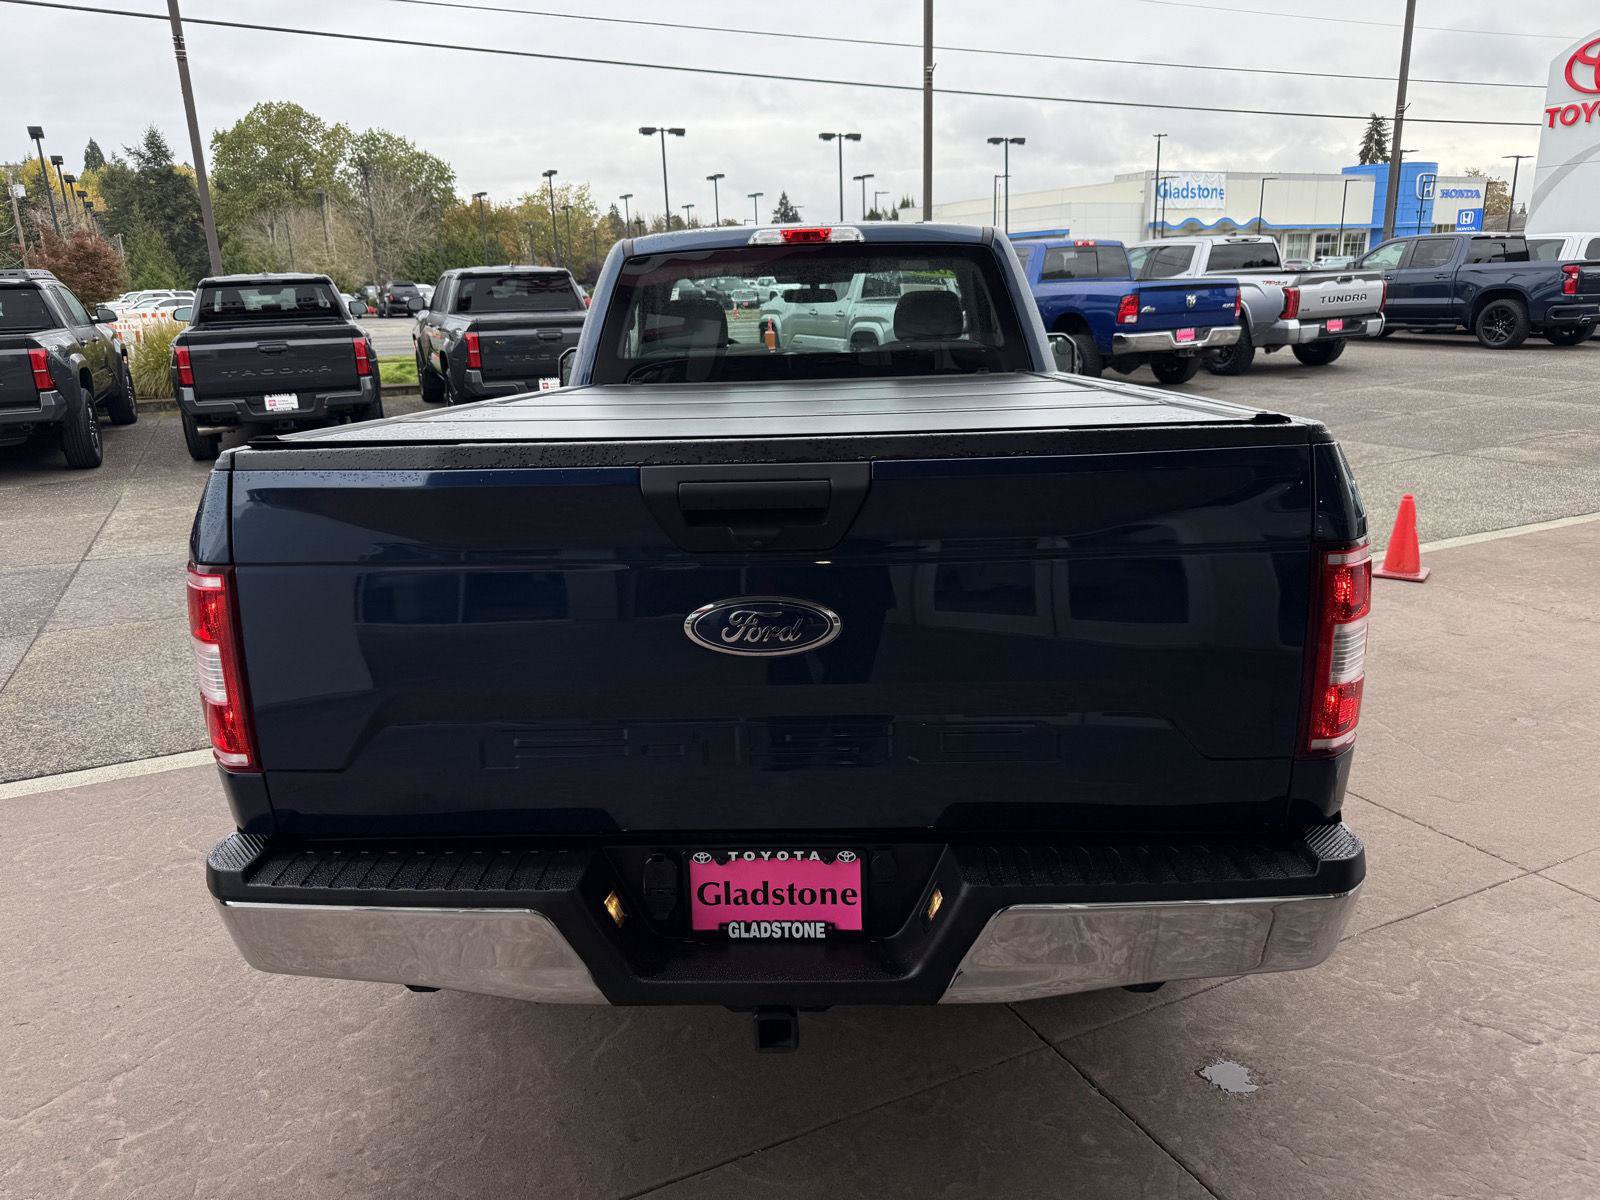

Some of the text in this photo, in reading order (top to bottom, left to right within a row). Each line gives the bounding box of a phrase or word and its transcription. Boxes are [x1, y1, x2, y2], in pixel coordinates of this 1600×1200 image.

[1545, 101, 1600, 129] TOY
[1157, 181, 1225, 200] Gladstone
[1439, 188, 1481, 199] HONDA
[1320, 293, 1367, 303] TUNDRA
[220, 365, 333, 378] TACOMA
[721, 610, 803, 643] Ford
[727, 850, 821, 862] TOYOTA
[696, 880, 858, 906] Gladstone
[727, 921, 826, 939] GLADSTONE
